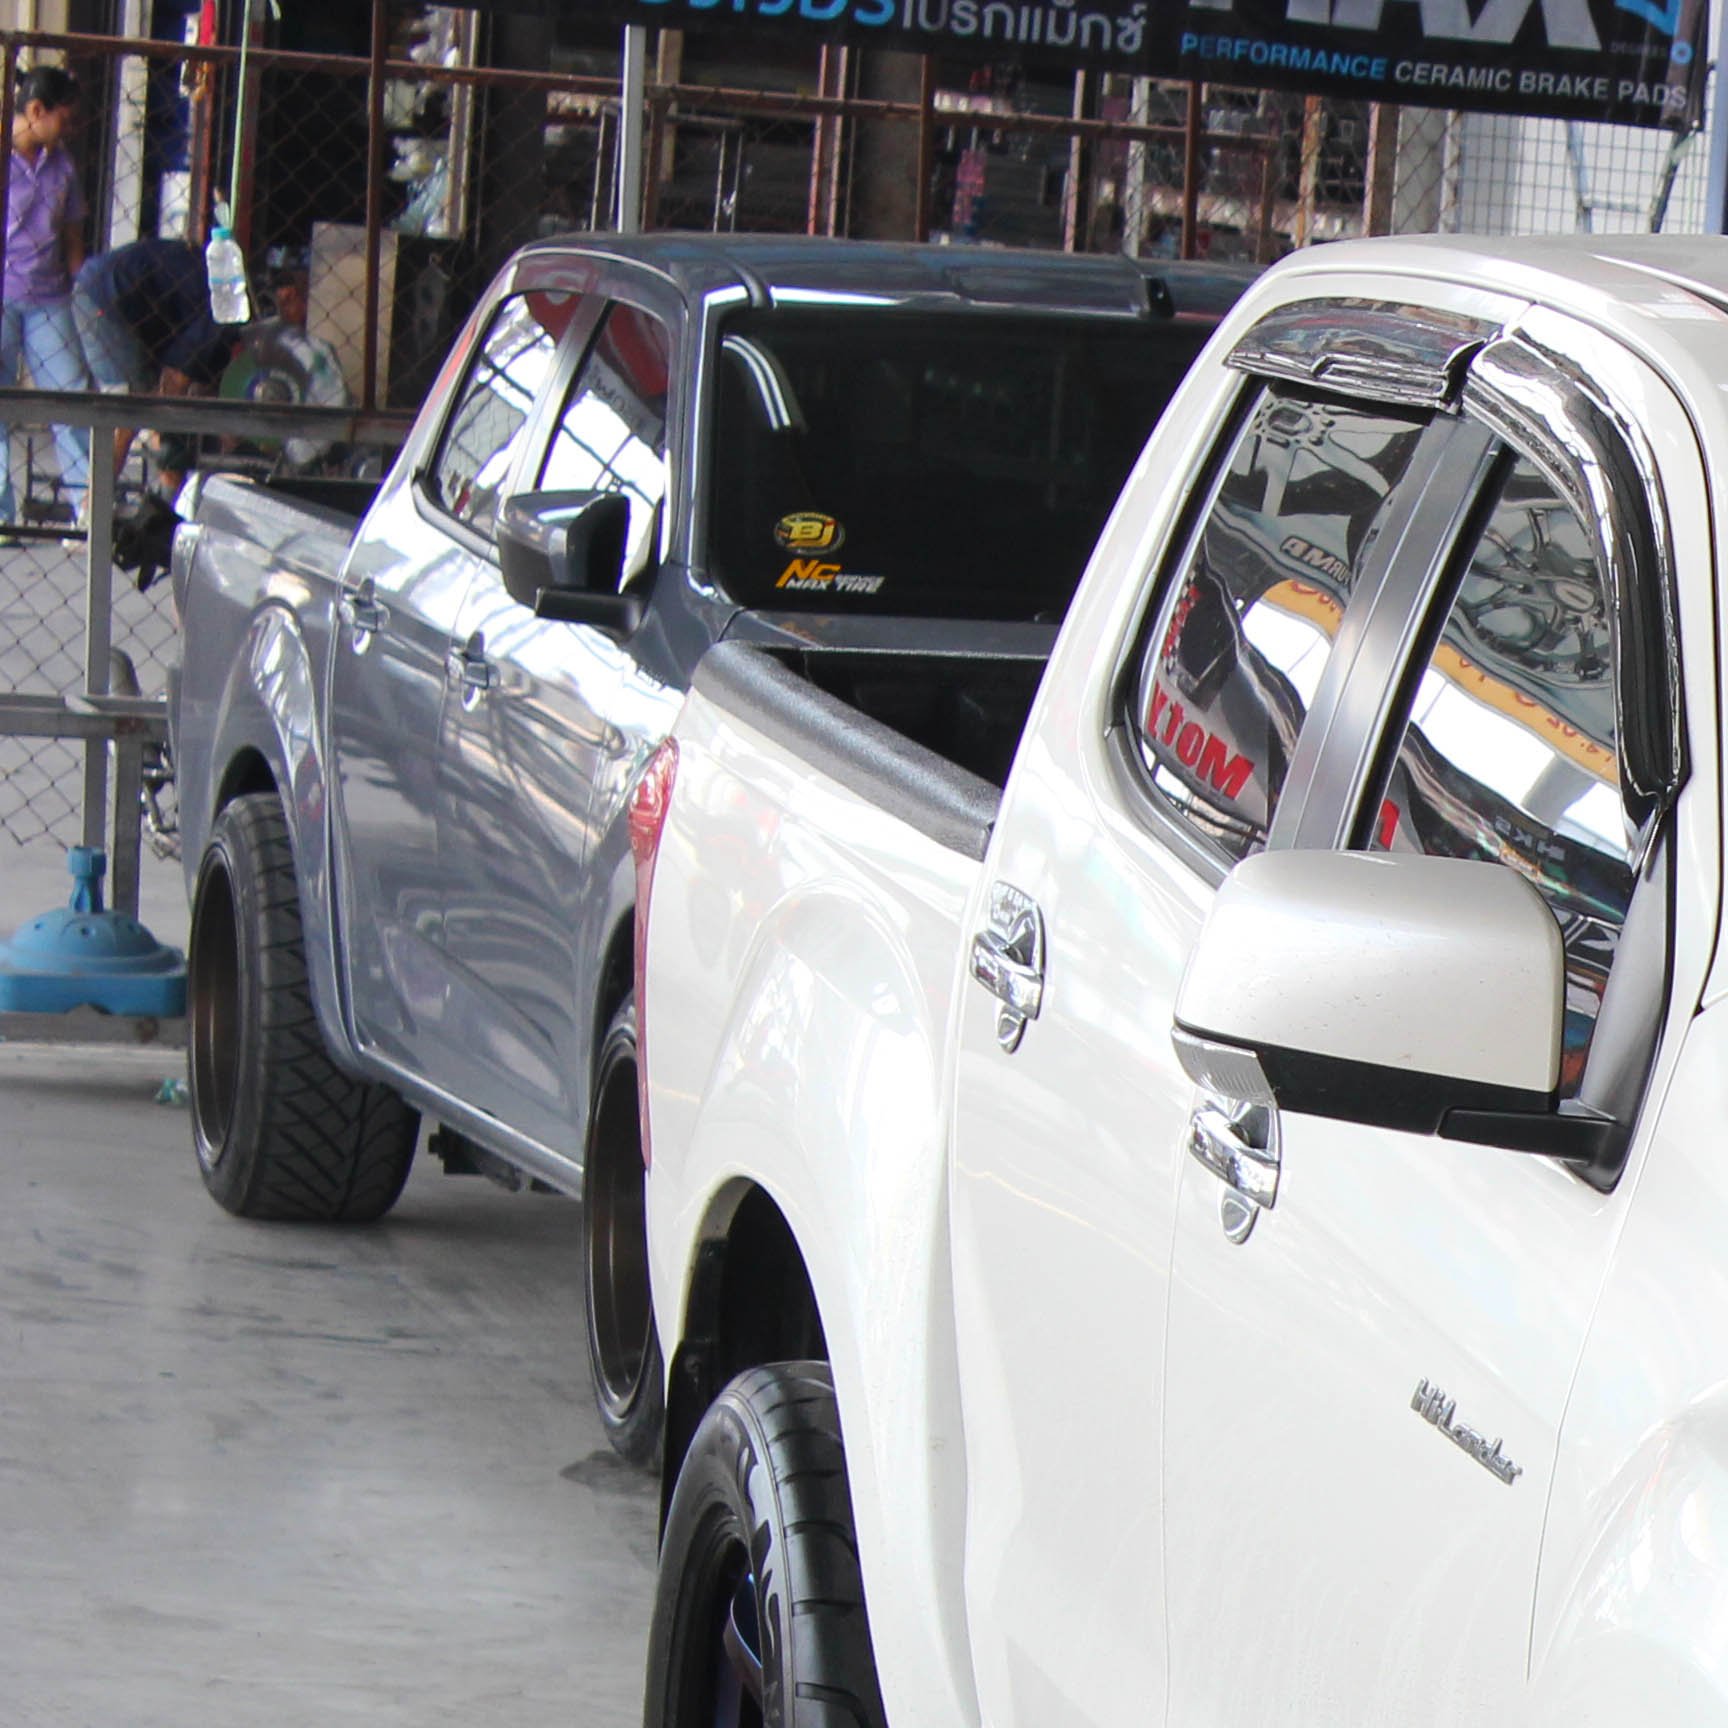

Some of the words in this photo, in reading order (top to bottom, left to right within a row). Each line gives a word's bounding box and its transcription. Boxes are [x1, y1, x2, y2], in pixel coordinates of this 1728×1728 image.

[1180, 33, 1386, 80] PERFORMANCE
[1395, 61, 1511, 91] CERAMIC
[1518, 71, 1609, 100] BRAKE
[1617, 80, 1687, 107] PADS
